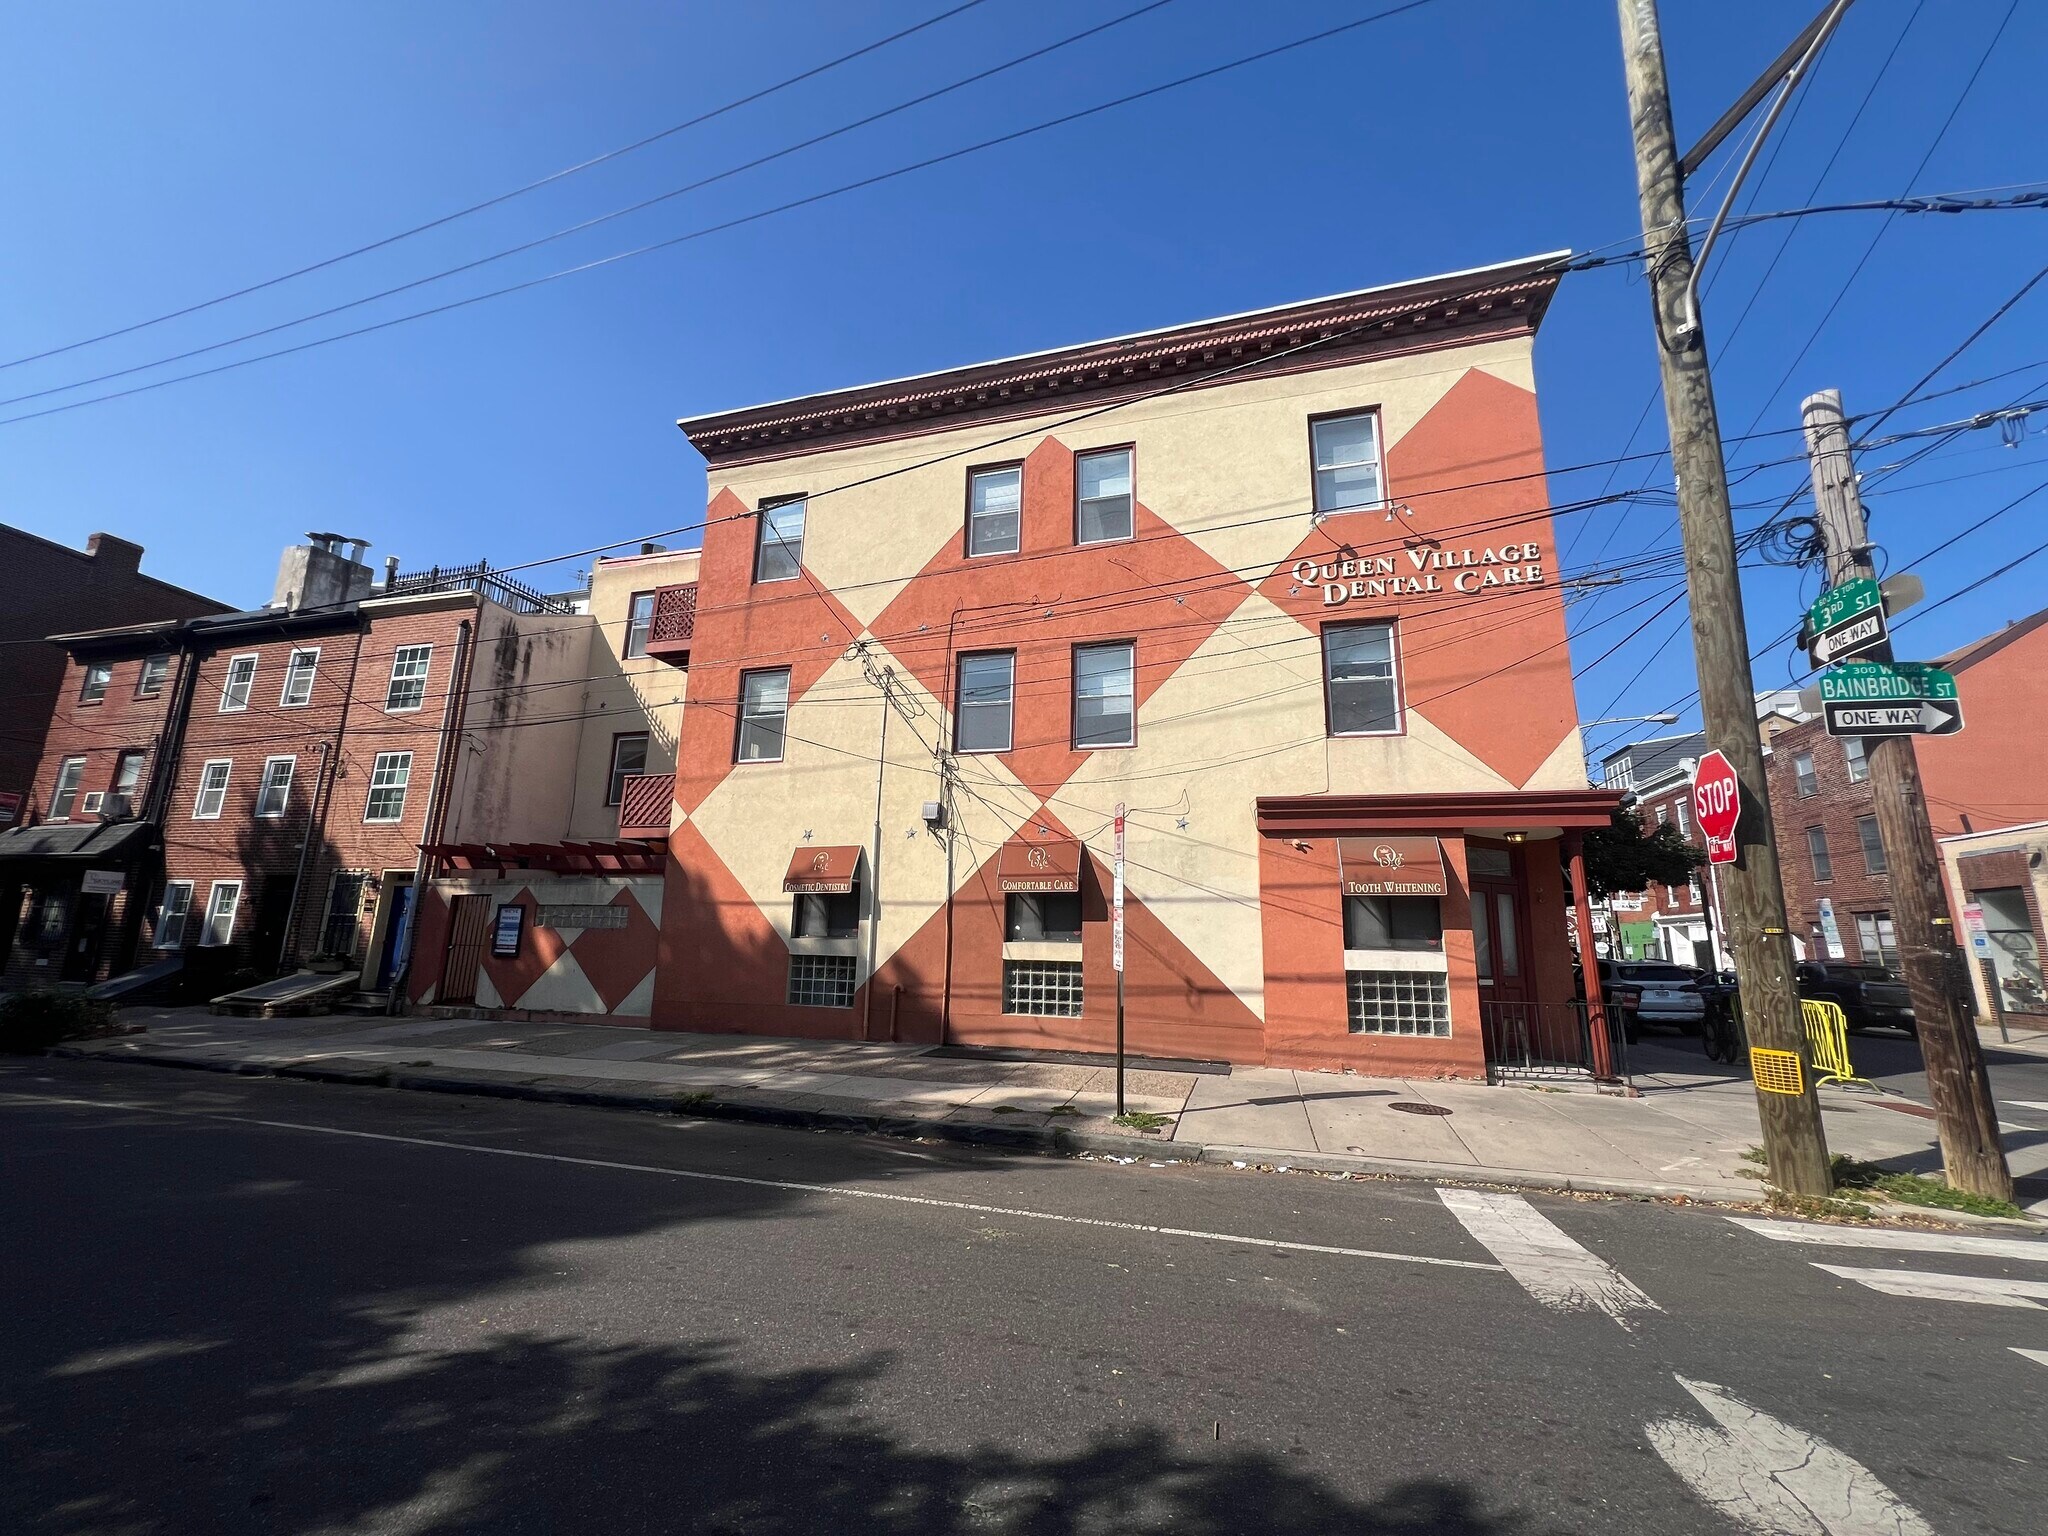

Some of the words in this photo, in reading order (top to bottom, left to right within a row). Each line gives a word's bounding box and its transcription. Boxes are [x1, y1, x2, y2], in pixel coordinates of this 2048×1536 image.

[1291, 555, 1397, 588] QUEEN
[1404, 542, 1541, 572] VILLAGE
[1321, 574, 1443, 607] DENTAL
[1453, 564, 1544, 595] CARE
[1832, 589, 1840, 600] S
[1820, 600, 1844, 627] 3RD
[1855, 591, 1872, 611] ST
[1828, 631, 1849, 651] ONE
[1850, 618, 1875, 641] WAY
[1852, 666, 1877, 675] 300
[1879, 664, 1893, 675] W
[1822, 676, 1931, 698] BAINBRIDGE
[1936, 682, 1952, 697] ST
[1842, 710, 1880, 725] ONE
[1885, 708, 1923, 724] WAY
[1696, 777, 1734, 818] STOP
[1710, 844, 1721, 854] ALL
[1723, 839, 1733, 852] WAY
[784, 882, 815, 892] COSMETIC
[815, 881, 849, 891] DENTISTRY
[1002, 879, 1052, 890] COMFORTABLE
[1053, 879, 1074, 890] CARE
[1348, 881, 1381, 893] TOOTH
[1383, 881, 1441, 893] WHITENING
